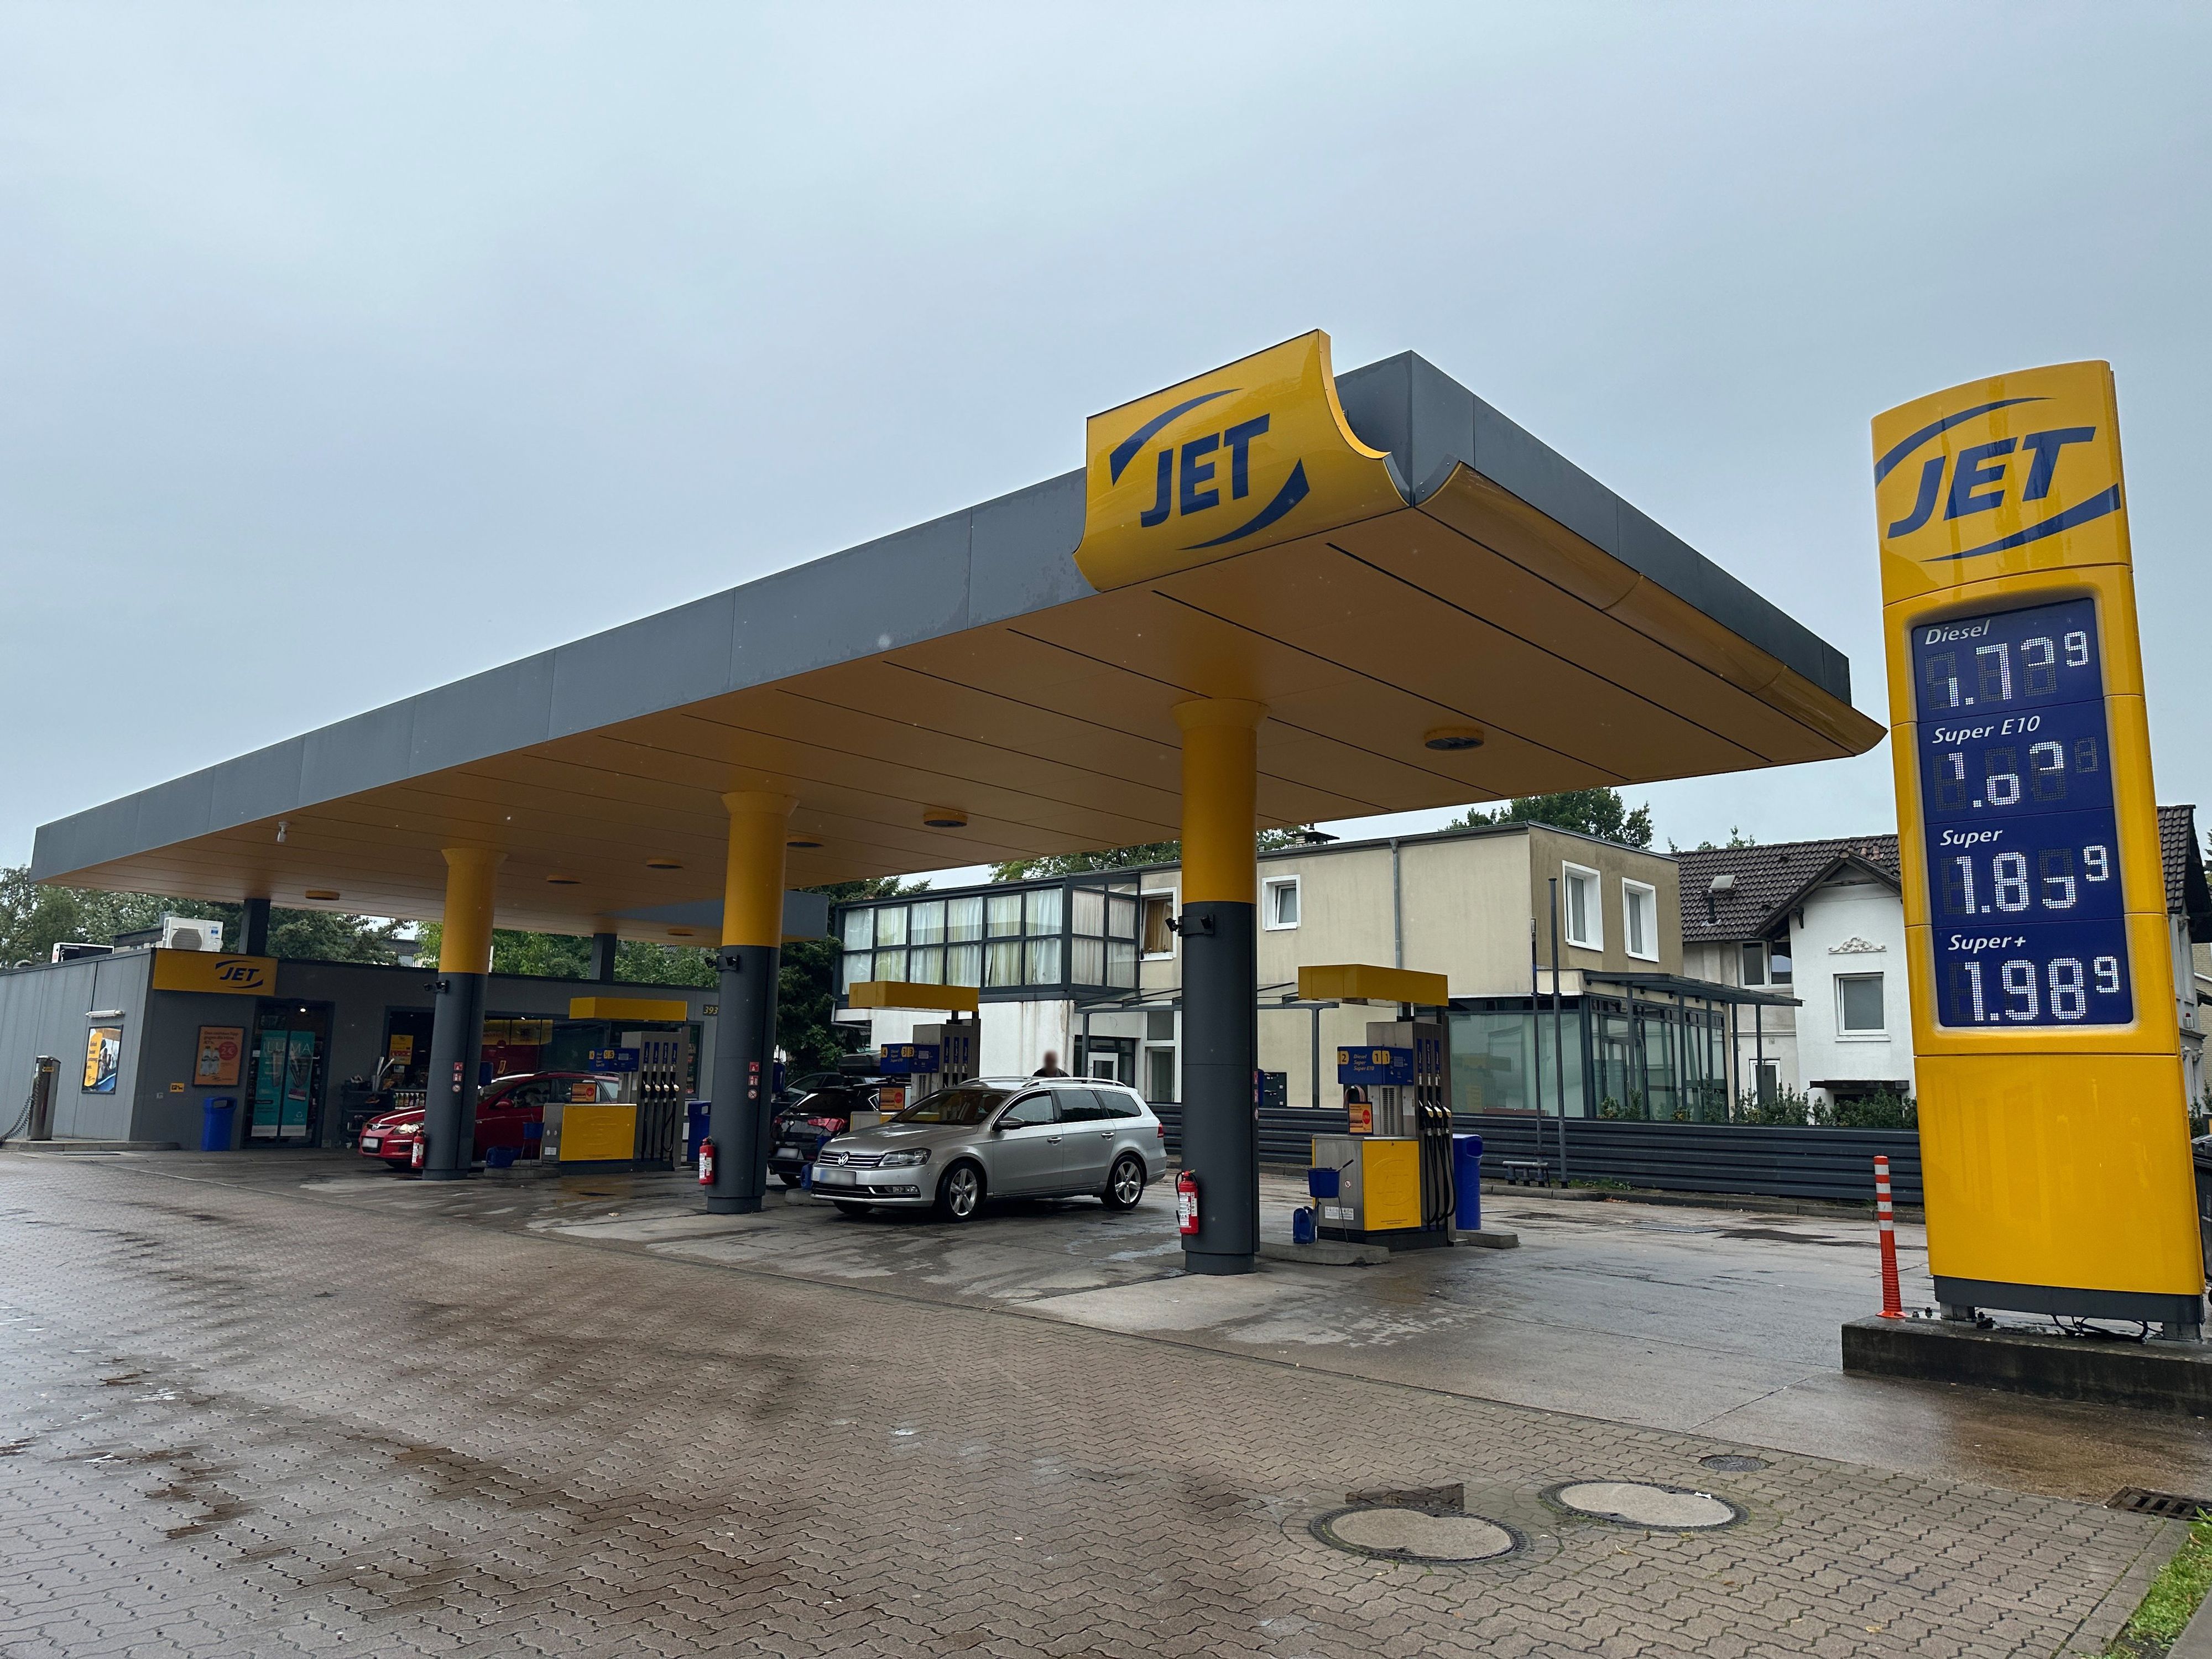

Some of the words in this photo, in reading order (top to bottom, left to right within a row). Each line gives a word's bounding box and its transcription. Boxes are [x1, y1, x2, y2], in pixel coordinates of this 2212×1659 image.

[1141, 414, 1270, 528] JET
[1887, 426, 2096, 539] JET
[1925, 619, 1991, 645] Diesel
[1932, 724, 1994, 745] Super
[2001, 715, 2041, 735] E10
[1939, 828, 2003, 848] Super
[1948, 932, 2026, 953] Super+
[220, 967, 260, 981] JET
[1964, 955, 2120, 1021] 1.989
[1342, 1054, 1347, 1062] 2
[1375, 1053, 1379, 1062] 1
[1385, 1053, 1389, 1062] 1
